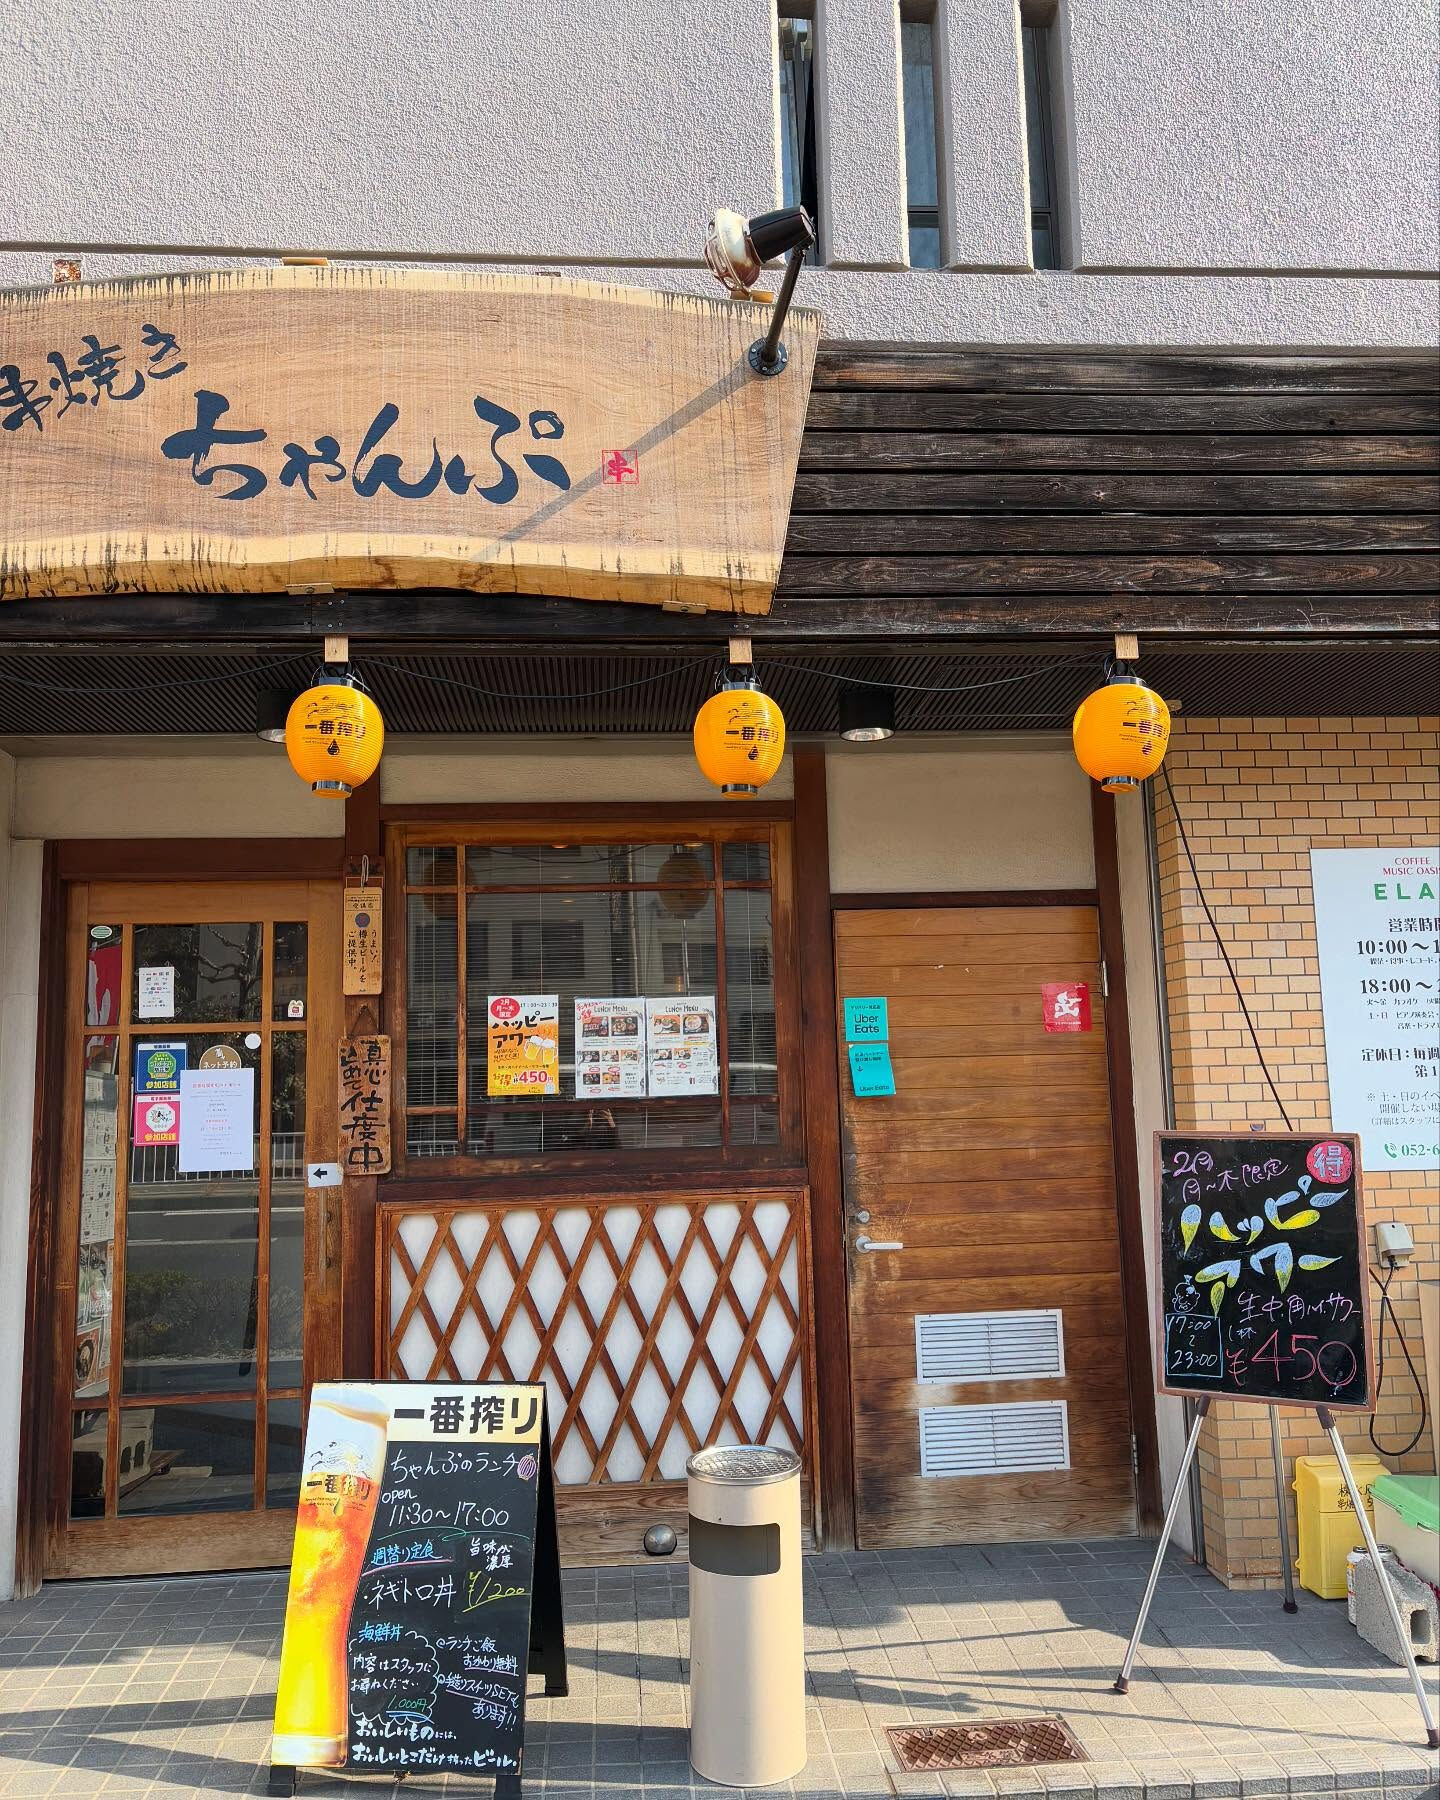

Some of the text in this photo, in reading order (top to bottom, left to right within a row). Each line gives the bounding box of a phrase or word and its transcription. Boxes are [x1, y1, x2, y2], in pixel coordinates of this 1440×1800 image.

[161, 390, 571, 505] ちゃんぷ
[305, 720, 366, 739] 一番搾り
[1383, 867, 1413, 875] MUSIC
[1394, 857, 1431, 865] COFFEE
[358, 930, 368, 982] 樽生ビールを
[492, 1010, 554, 1030] ハッピー
[854, 1013, 879, 1023] Uber
[854, 1024, 880, 1034] Eats
[1313, 1145, 1343, 1178] 得
[1181, 1174, 1349, 1258] ハッピー
[1194, 1242, 1343, 1319] アワー
[1171, 1349, 1218, 1370] 23:00
[394, 1395, 538, 1435] 一番搾り
[381, 1488, 418, 1504] open
[358, 1621, 404, 1644] 海鮮丼
[353, 1652, 432, 1675] 内容はスタッフに
[350, 1677, 419, 1695] お尋ねください
